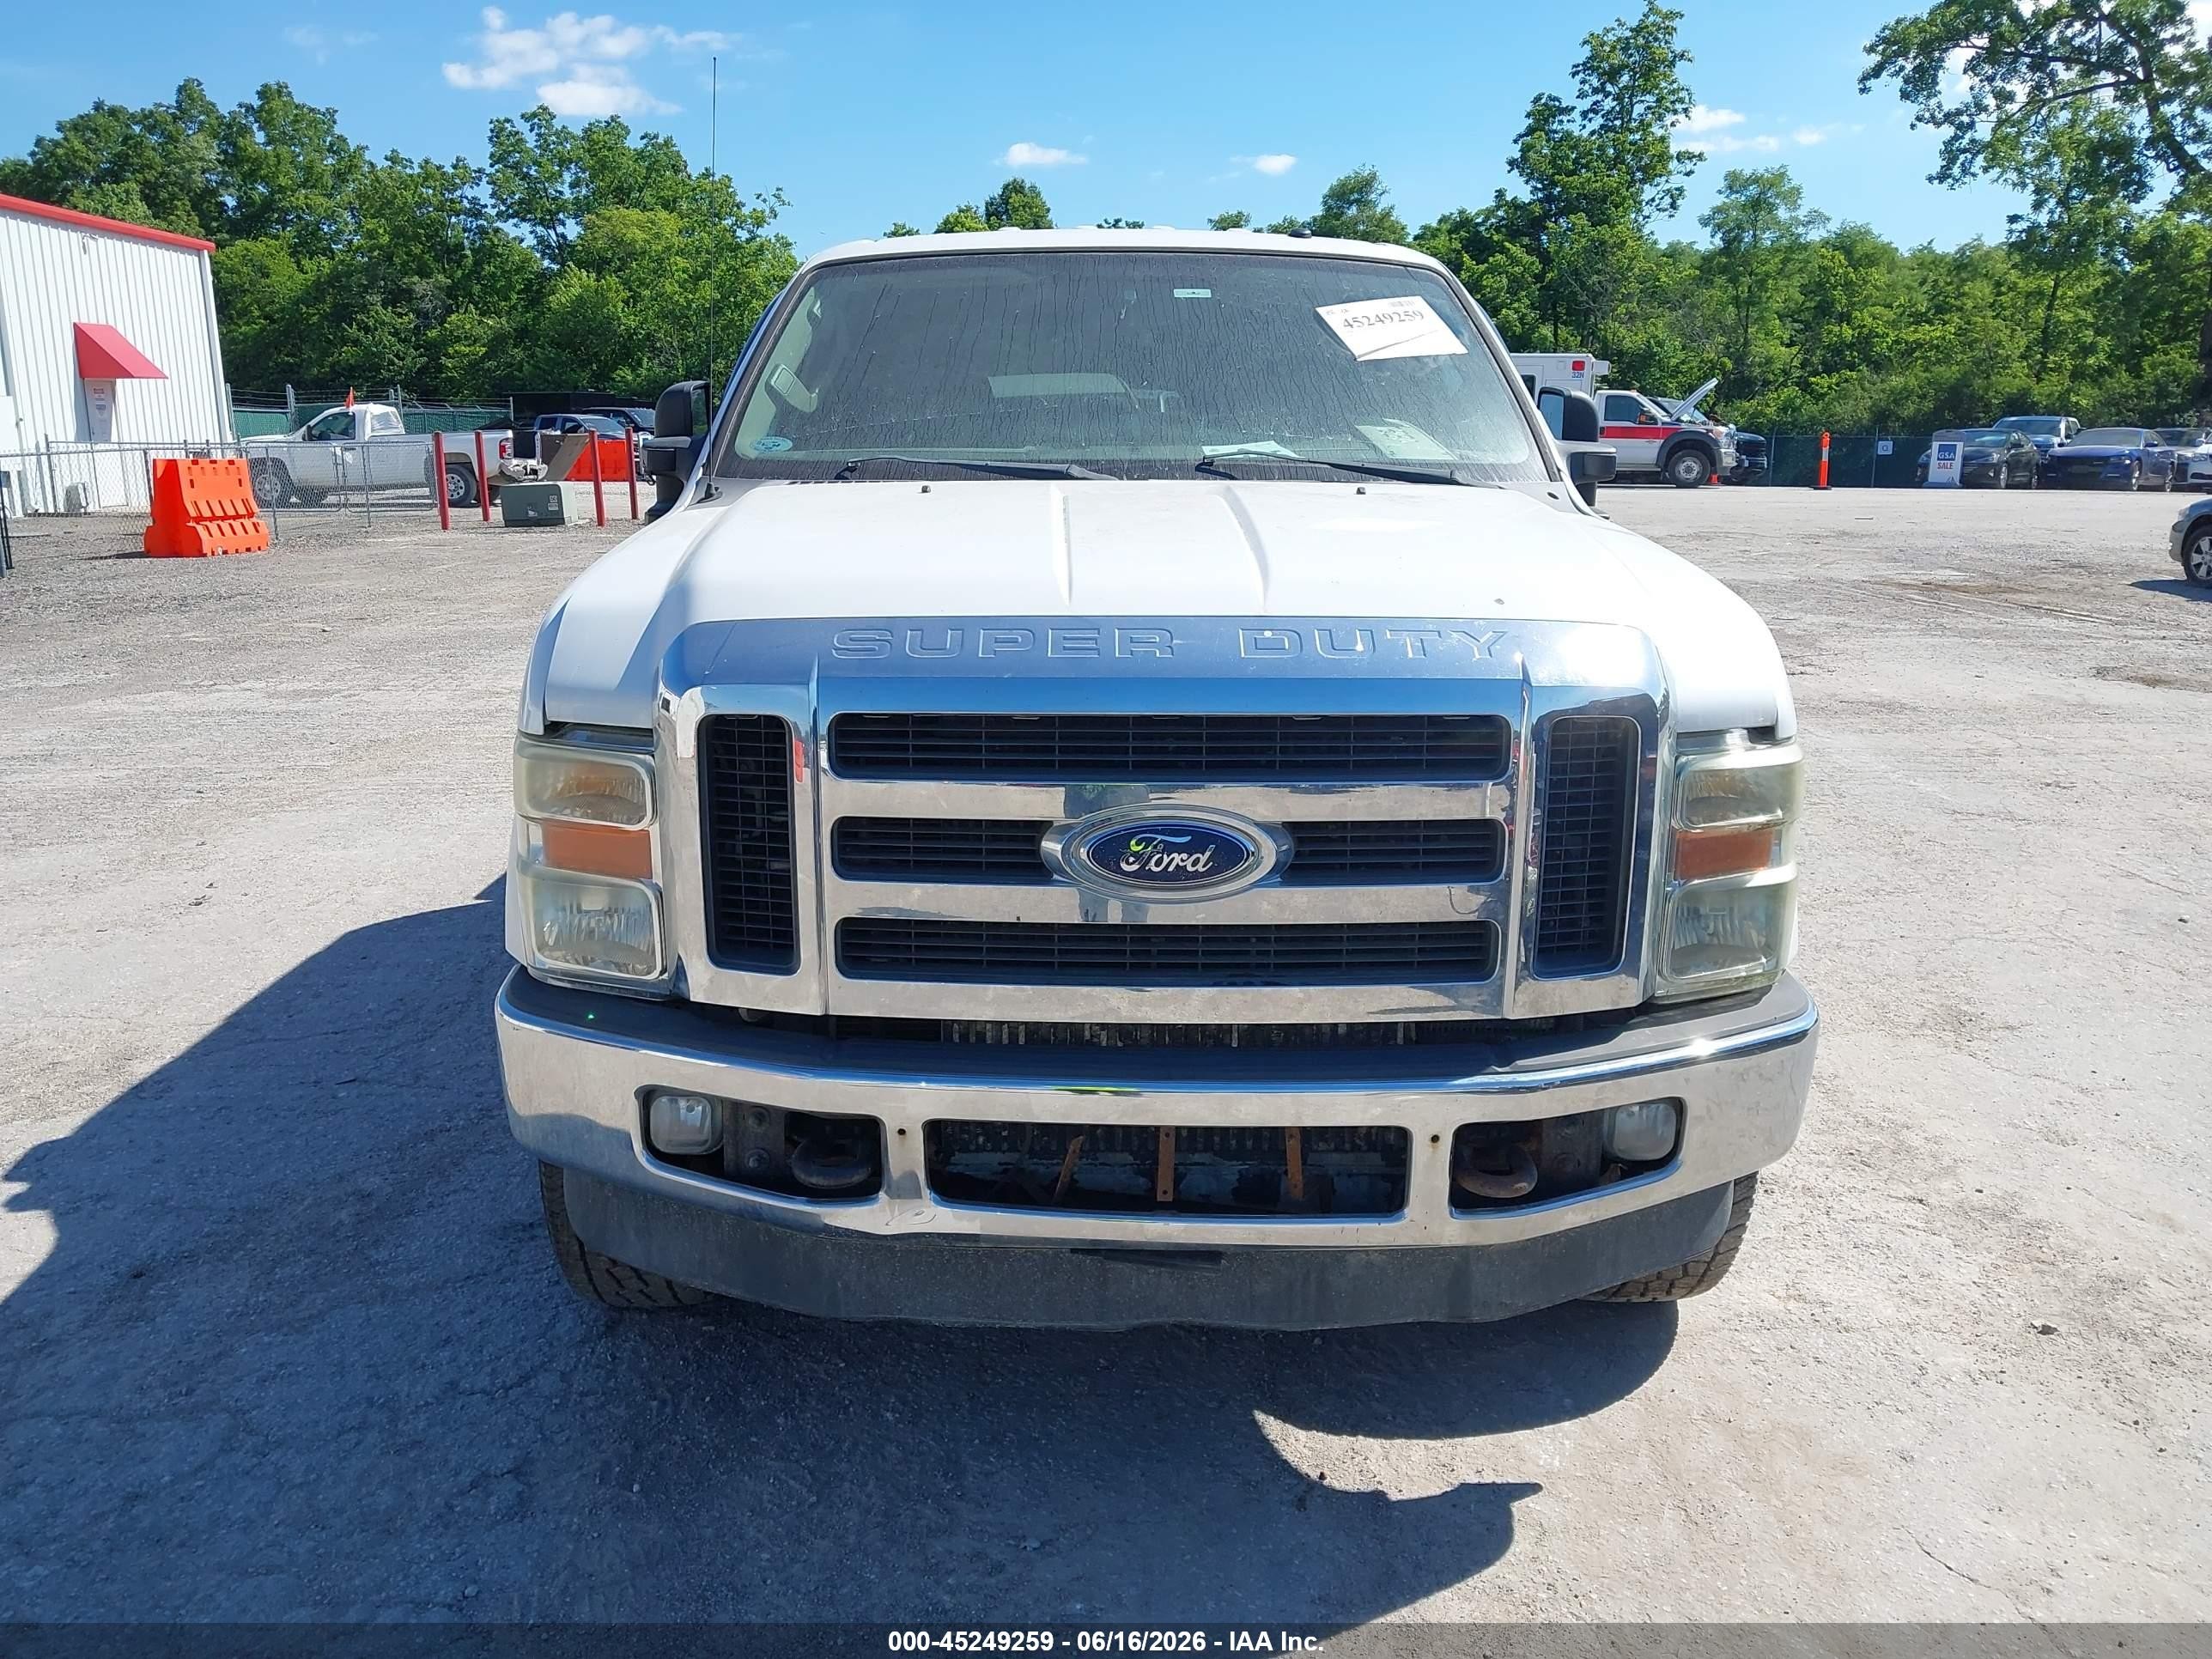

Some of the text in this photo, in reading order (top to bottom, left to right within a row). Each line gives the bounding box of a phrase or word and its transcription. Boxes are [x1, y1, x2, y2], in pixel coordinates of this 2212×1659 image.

[1343, 310, 1425, 329] 45249259
[831, 628, 1509, 659] SUPER DUTY
[1120, 834, 1219, 872] Ford
